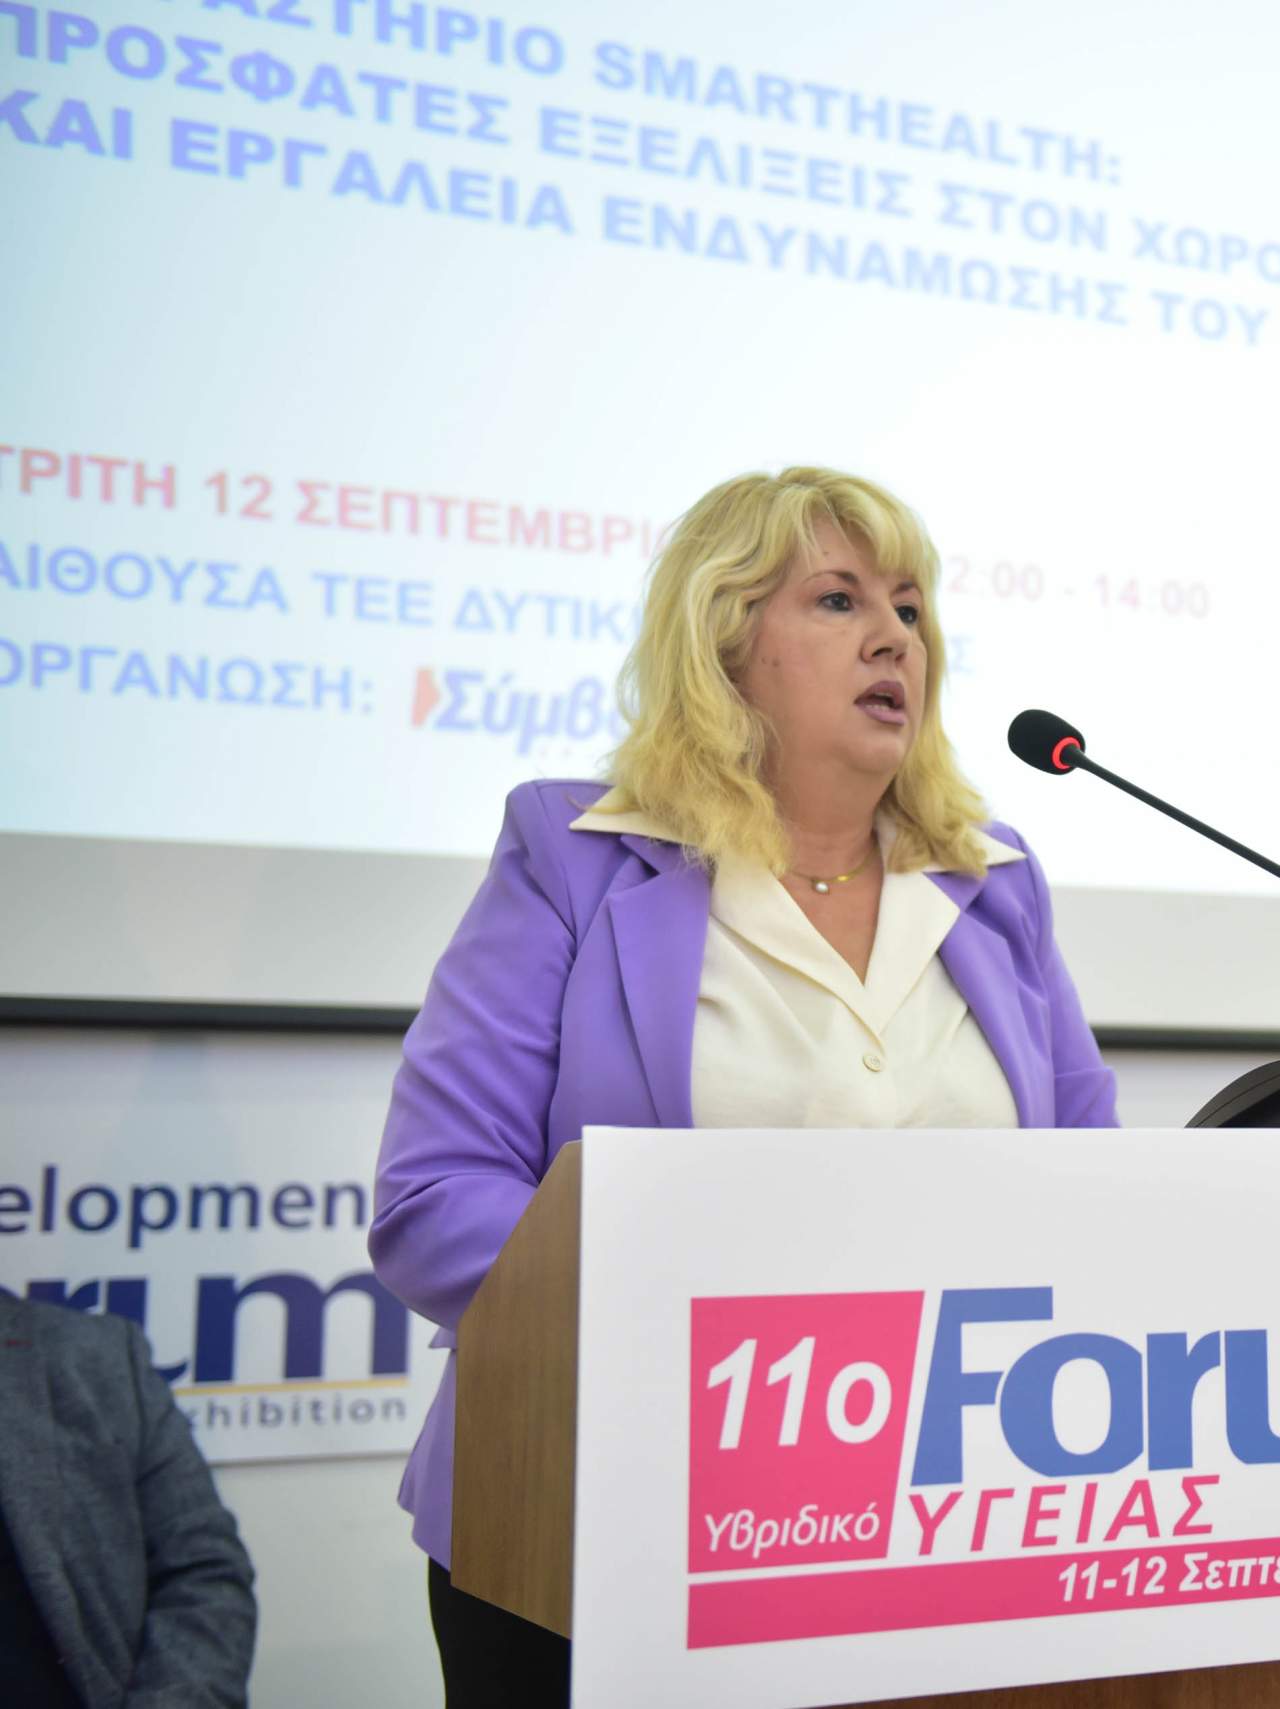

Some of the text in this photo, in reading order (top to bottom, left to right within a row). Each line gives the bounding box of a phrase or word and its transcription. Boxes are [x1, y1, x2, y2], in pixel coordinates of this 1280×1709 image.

[198, 0, 1122, 187] ΣΤΗΡΙΟ SMARTHEALTH:
[170, 117, 576, 237] ΕΡΓΑΛΕΙΑ
[600, 194, 1128, 328] ΕΝΔΥΝΑΜΩΣΗΣ
[1151, 290, 1270, 349] ΤΟΥ
[537, 105, 912, 219] ΕΞΕΛΙΞΕΙΣ
[936, 180, 1108, 253] ΣΤΟΝ
[204, 468, 273, 522] 12
[944, 555, 1046, 603] 2:00
[310, 569, 434, 627] ΤΕΕ
[452, 586, 642, 643] ΔΥΤΙΚ
[704, 1503, 880, 1559] Υβριδικό
[908, 1474, 1220, 1557] ΥΓΕΙΑΣ
[1058, 1556, 1167, 1602] 11-12
